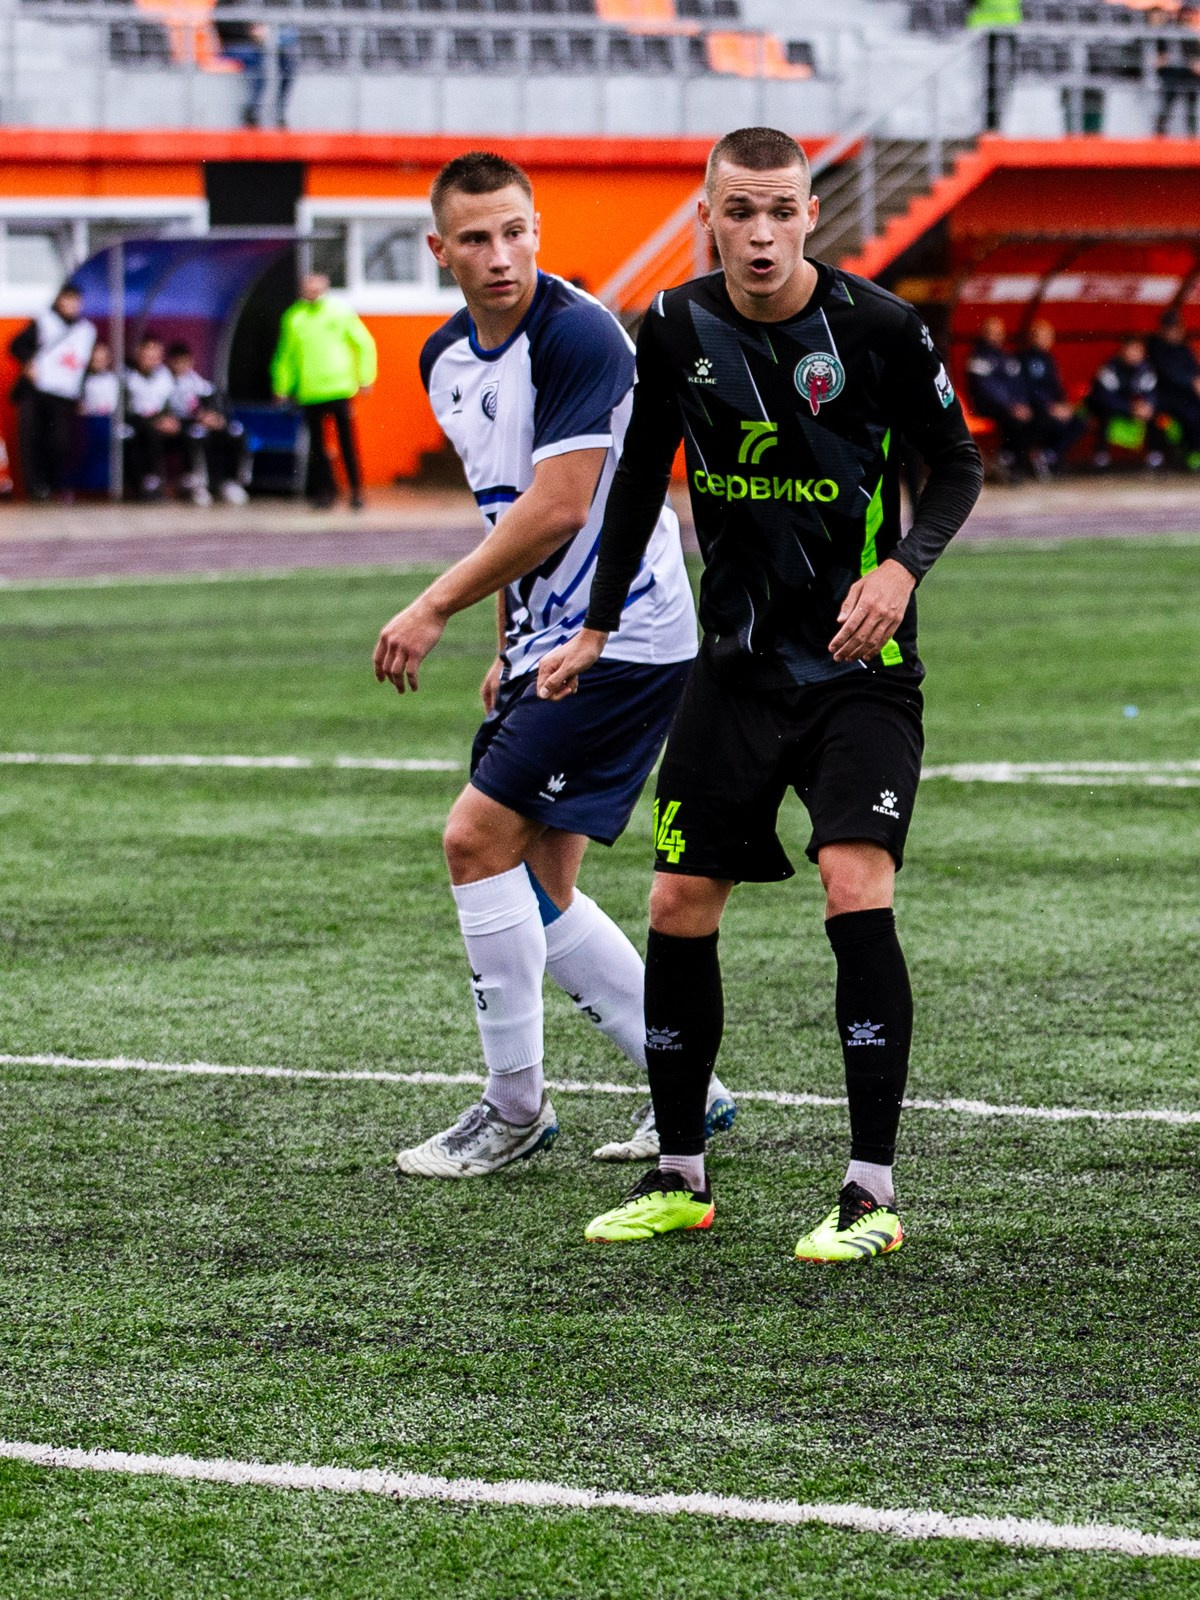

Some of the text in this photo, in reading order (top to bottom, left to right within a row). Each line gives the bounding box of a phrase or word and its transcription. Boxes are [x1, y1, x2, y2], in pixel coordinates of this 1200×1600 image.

[688, 376, 718, 385] KELME
[693, 469, 840, 502] сервико
[872, 804, 900, 819] KELME
